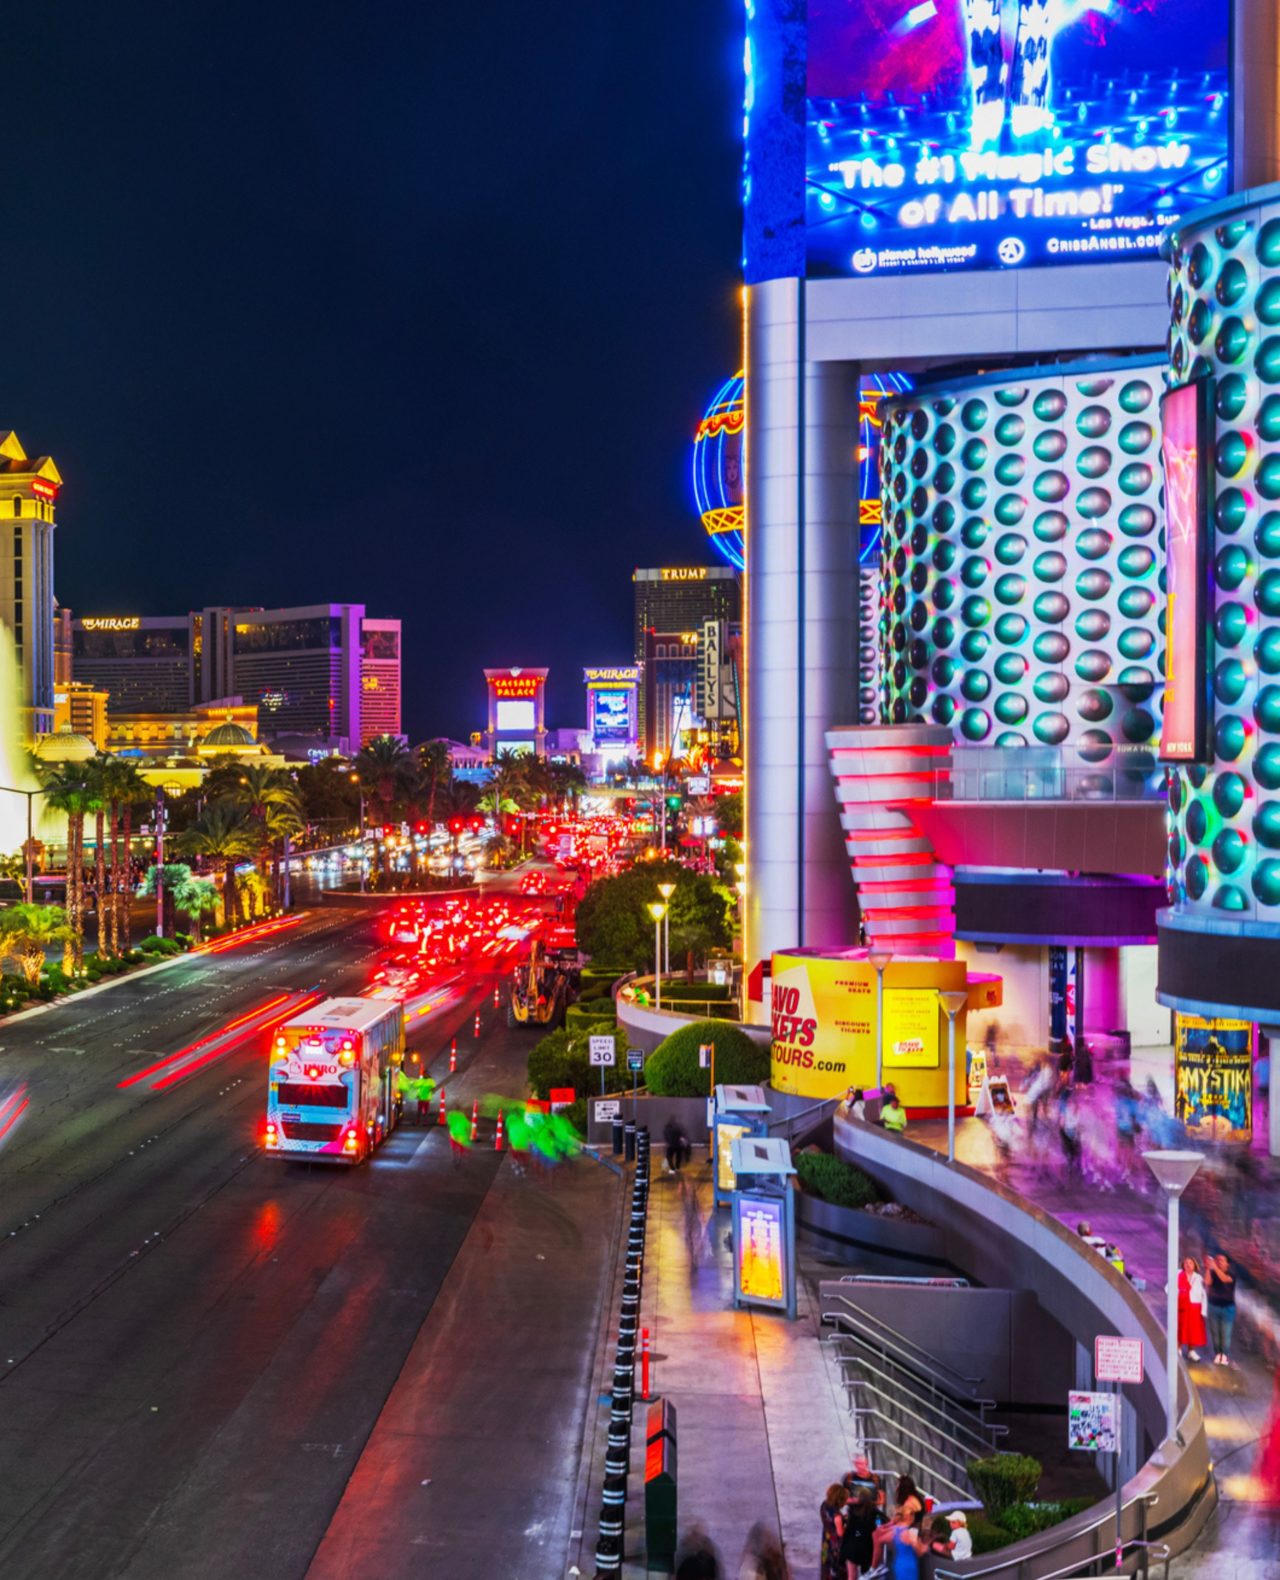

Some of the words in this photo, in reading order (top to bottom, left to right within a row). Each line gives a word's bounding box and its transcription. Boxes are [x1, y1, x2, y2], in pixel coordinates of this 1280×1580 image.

[915, 155, 955, 184] #1
[960, 147, 1075, 183] Magic
[1086, 143, 1190, 173] Show
[898, 193, 941, 228] of
[948, 190, 998, 222] All
[1090, 218, 1112, 230] Las
[662, 568, 707, 580] TRUMP
[86, 617, 140, 631] MIRAGE
[590, 669, 639, 681] MIRAGE
[495, 679, 537, 688] CAESARS
[497, 688, 535, 697] PALACE
[593, 1052, 612, 1062] 30
